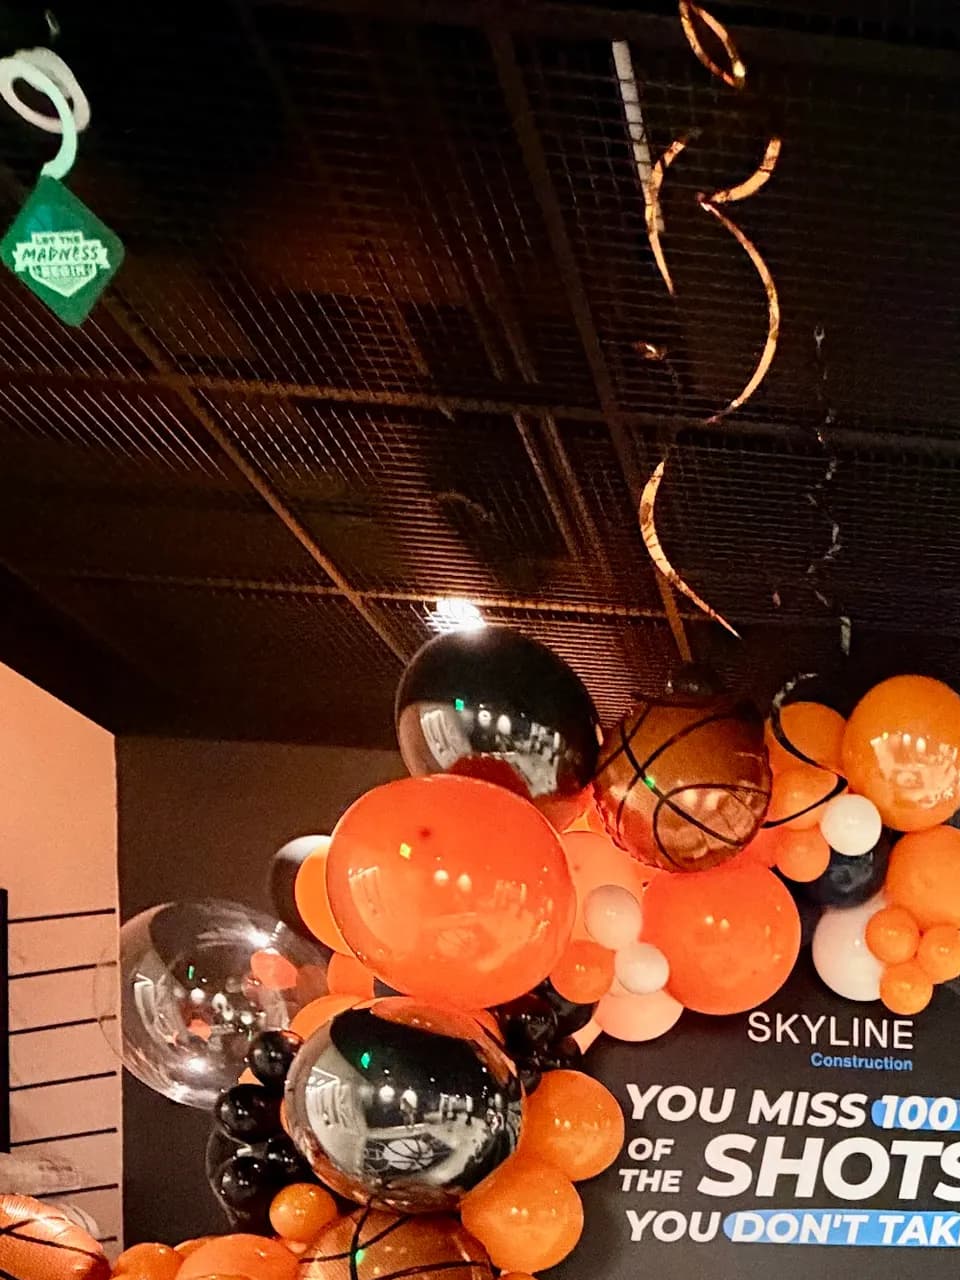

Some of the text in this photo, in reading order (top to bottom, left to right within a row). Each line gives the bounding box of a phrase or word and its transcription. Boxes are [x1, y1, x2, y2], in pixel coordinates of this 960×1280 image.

[58, 235, 81, 245] THE
[21, 246, 99, 262] MADNESS
[747, 1011, 914, 1050] SKYLINE
[810, 1052, 913, 1071] Construction
[626, 1083, 737, 1124] YOU
[747, 1089, 869, 1129] MISS
[627, 1137, 675, 1162] OF
[618, 1168, 683, 1194] THE
[625, 1209, 722, 1243] YOU
[730, 1210, 869, 1245] DON'T
